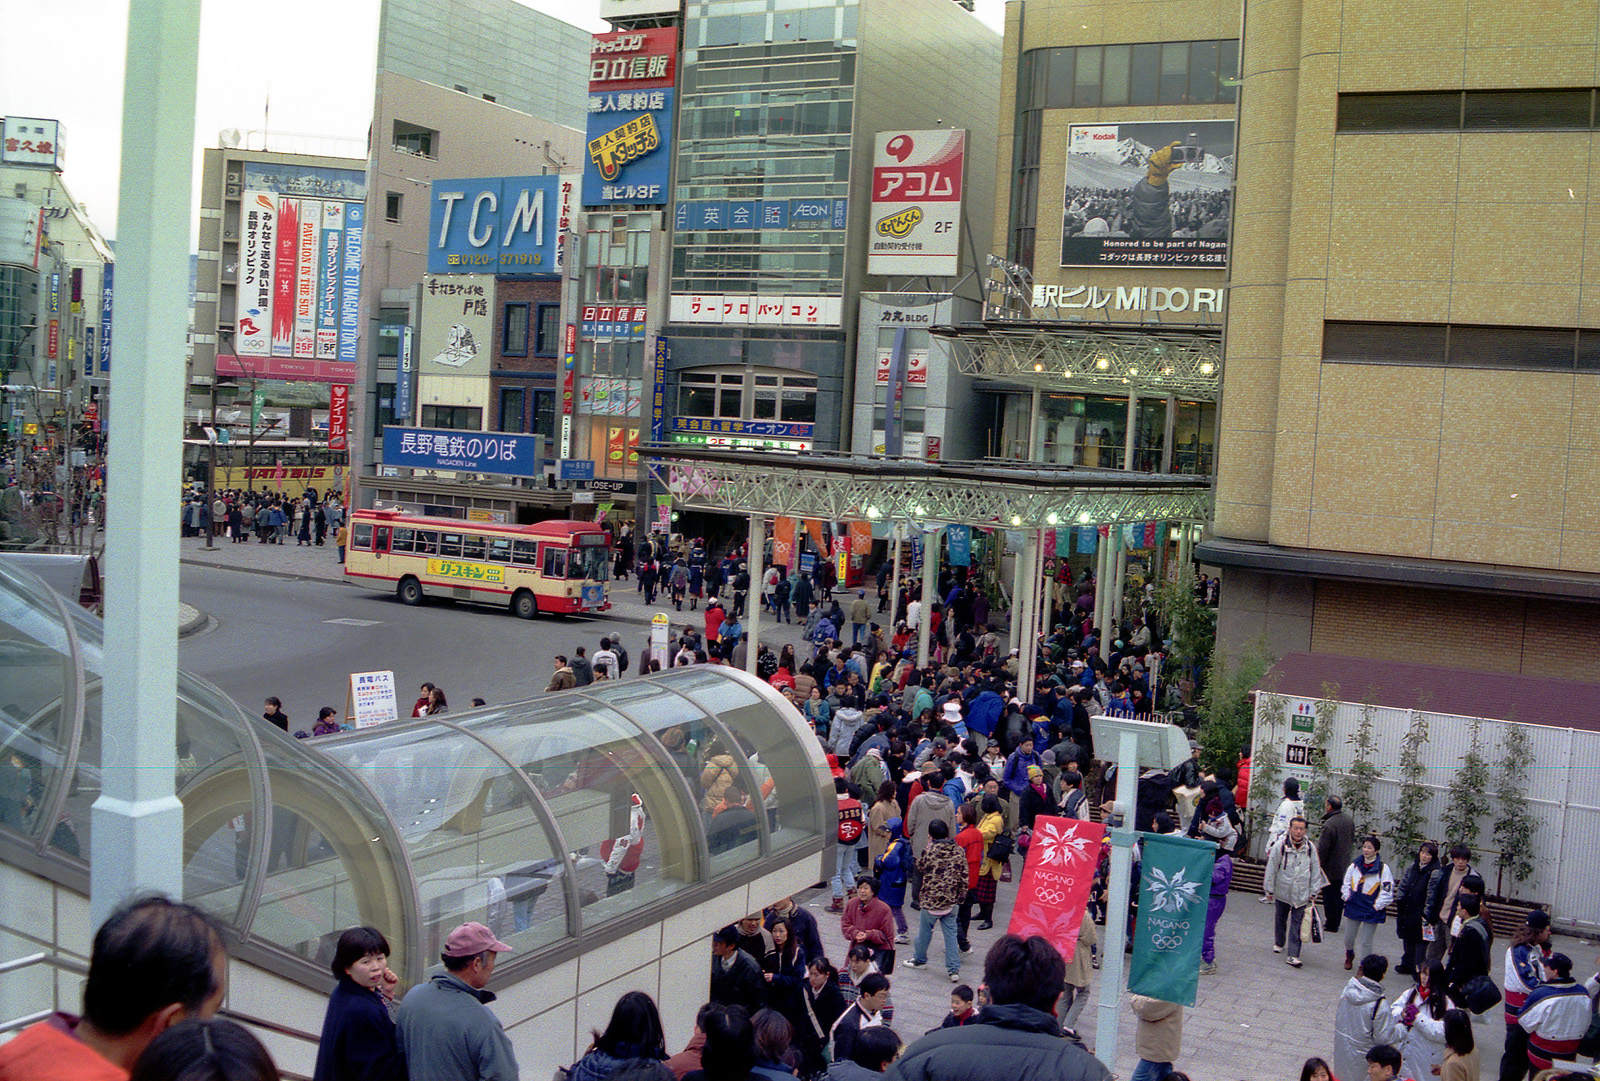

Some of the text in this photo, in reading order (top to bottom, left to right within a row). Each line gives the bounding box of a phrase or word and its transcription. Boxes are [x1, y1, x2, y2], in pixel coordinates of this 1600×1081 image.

[589, 55, 669, 82] 日立信販
[588, 92, 665, 113] 無人契約店
[590, 115, 652, 153] 無人契約店
[602, 184, 660, 200] 当ビル3F
[879, 172, 953, 198] アコム
[437, 188, 545, 248] TCM
[703, 206, 781, 225] 英会話
[880, 211, 920, 235] むじんくん
[934, 221, 953, 234] 2F
[245, 211, 259, 285] 長野オリンピック
[1166, 240, 1185, 249] part
[1199, 240, 1227, 249] Nagan
[299, 222, 314, 317] PAVILION IN THE SUN
[341, 227, 362, 358] WELCOME TO NAGANO TOKYU
[427, 278, 485, 296] 手打ちそば処
[463, 299, 488, 316] 戸隠
[1031, 285, 1224, 313] 駅ビル MIDORI
[584, 307, 647, 321] 日立信販
[881, 310, 929, 323] 力丸 BLDG
[100, 288, 112, 362] ホテル ニューナガノ
[301, 342, 313, 351] 5F
[323, 343, 336, 351] 5F
[332, 397, 345, 436] アイフル
[400, 432, 516, 461] 長野電鉄のりば
[437, 457, 477, 469] NAGADEN Line
[290, 468, 326, 479] BUS
[440, 564, 485, 579] リースキン
[359, 675, 389, 684] 長電バス
[1034, 871, 1074, 886] NAGANO
[1148, 917, 1190, 929] NAGANO
